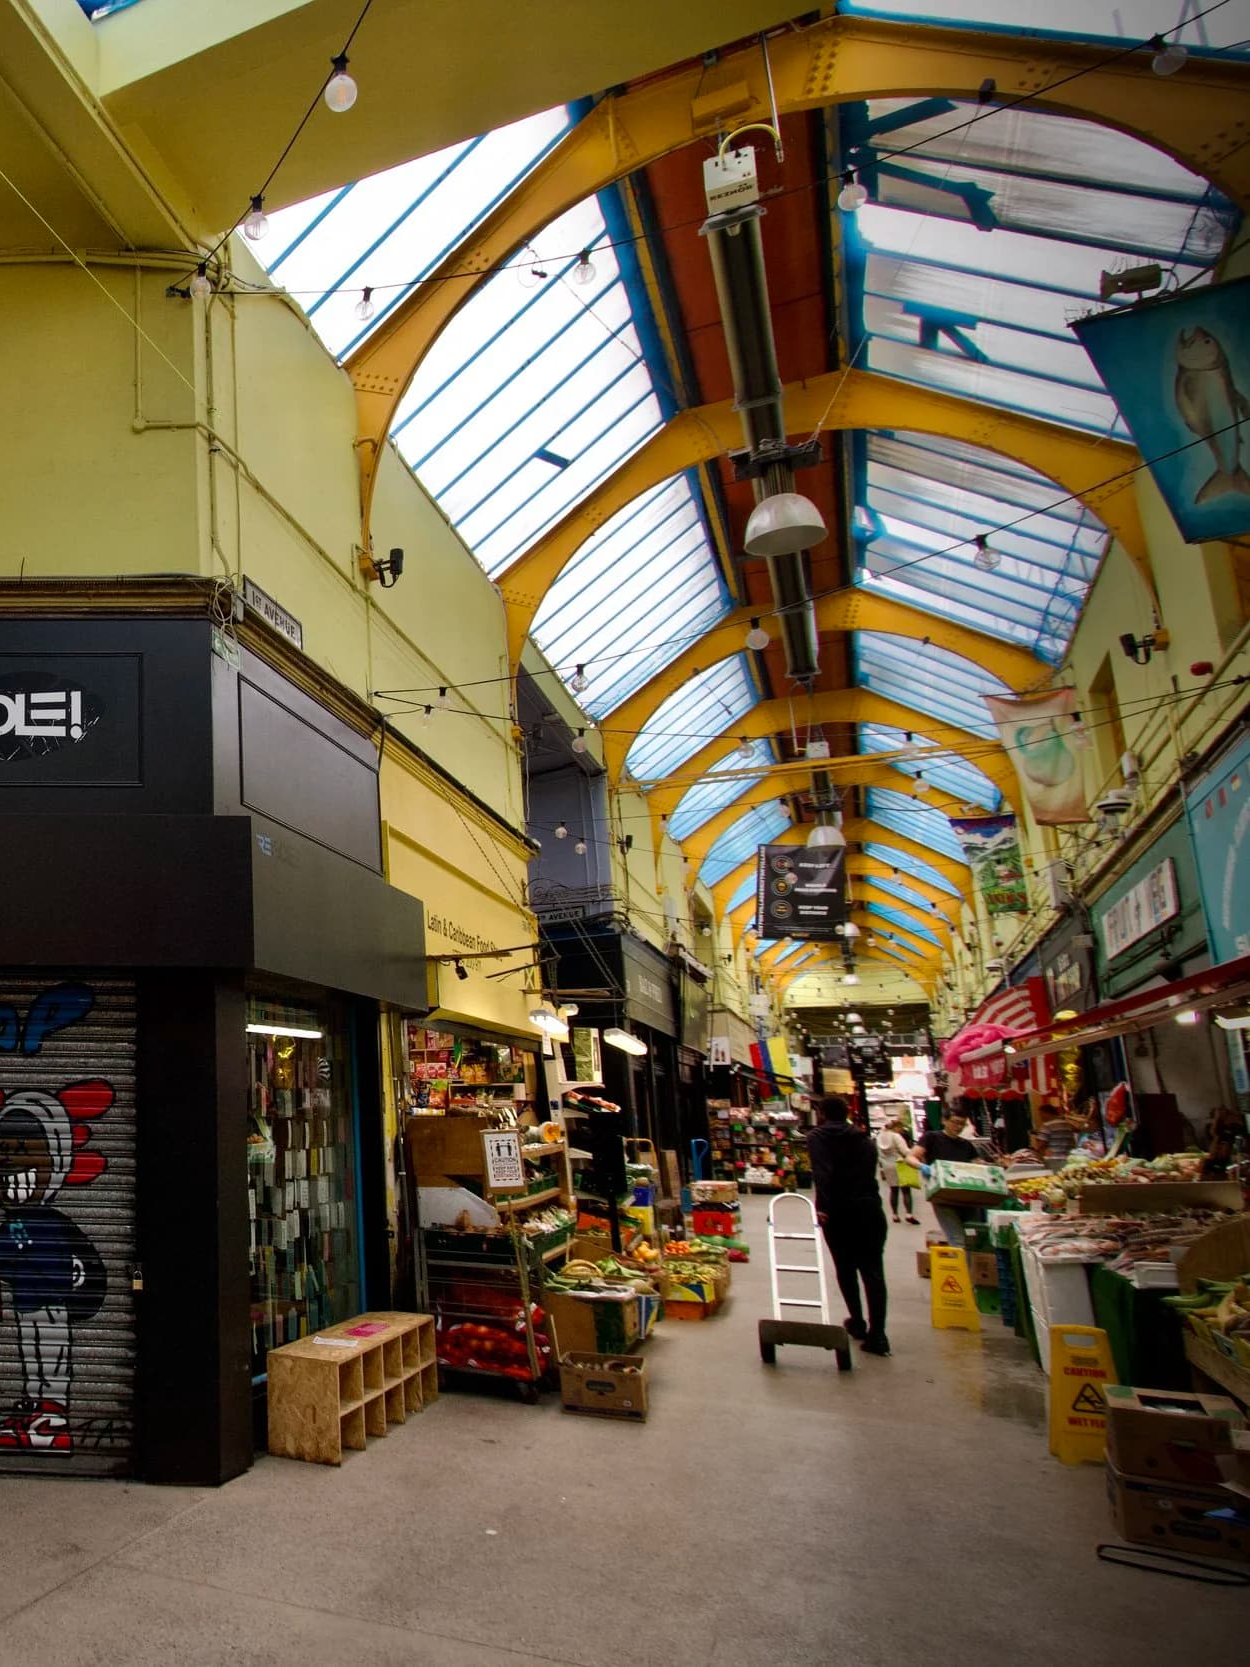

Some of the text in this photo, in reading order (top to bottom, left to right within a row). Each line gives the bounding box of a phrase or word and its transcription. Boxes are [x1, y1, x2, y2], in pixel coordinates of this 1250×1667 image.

[264, 603, 296, 640] AVENUE
[548, 911, 580, 920] AVENUE
[427, 910, 442, 936] Latin
[443, 918, 448, 937] &
[448, 922, 476, 950] Caribbean
[1063, 1367, 1107, 1378] CAUTION
[1068, 1417, 1087, 1426] WET
